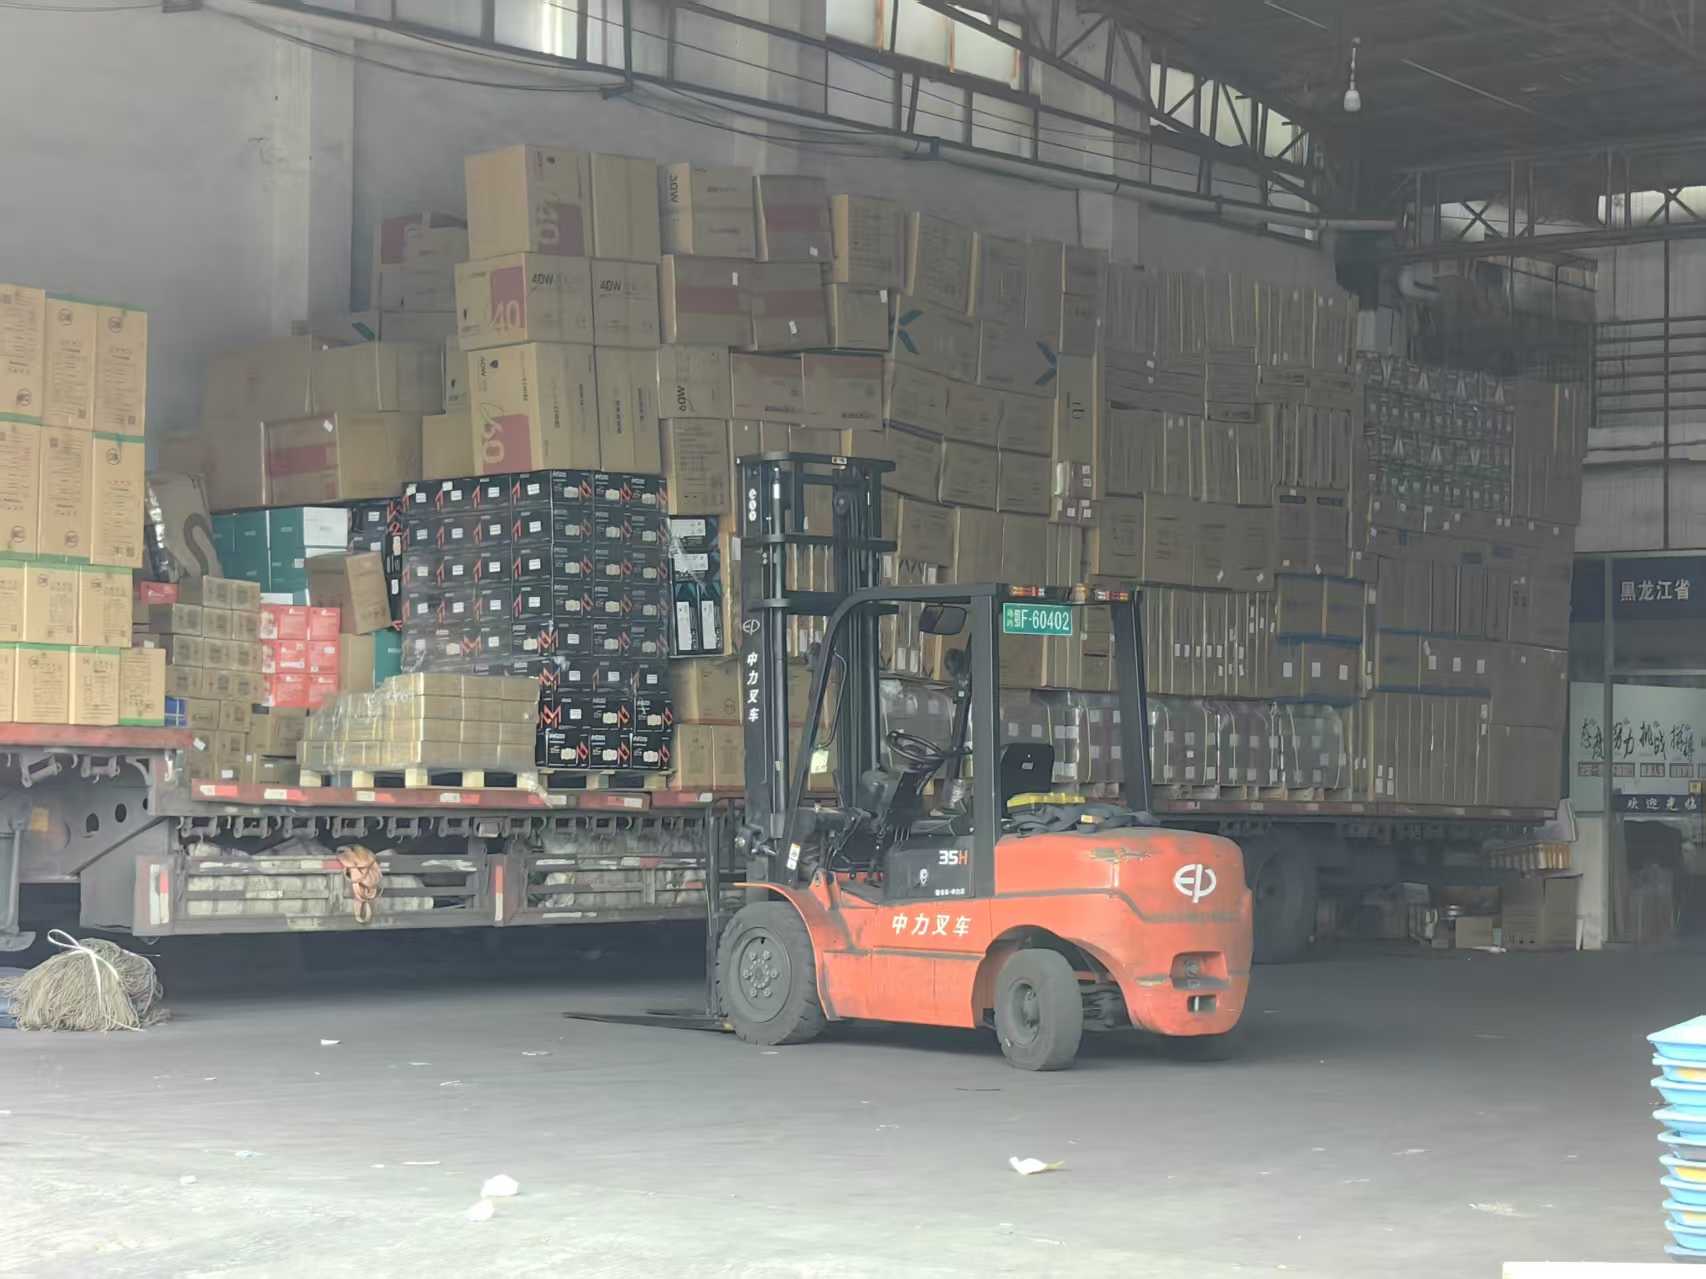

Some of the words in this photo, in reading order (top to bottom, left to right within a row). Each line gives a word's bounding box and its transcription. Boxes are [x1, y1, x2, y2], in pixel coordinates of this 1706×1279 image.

[1620, 577, 1691, 601] 黑龙江省
[746, 651, 760, 722] 中力叉车
[938, 849, 968, 865] 35H
[891, 912, 971, 937] 中力叉车
